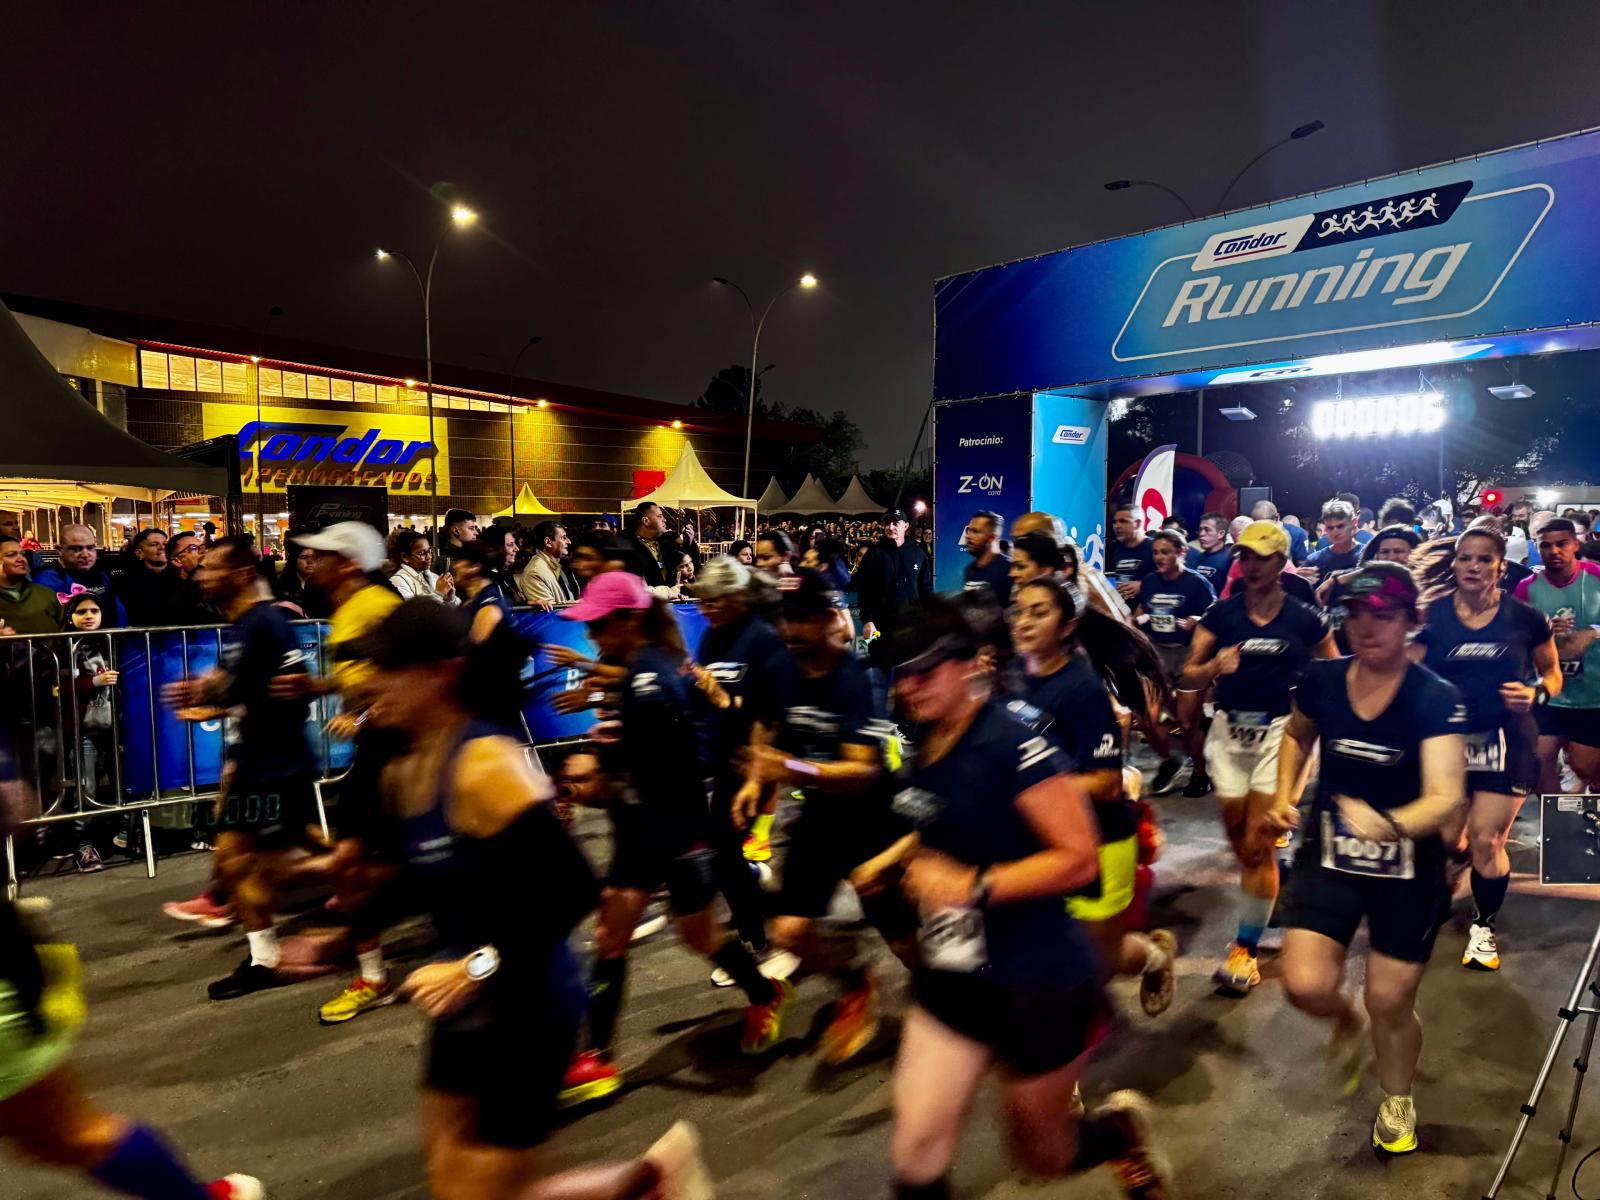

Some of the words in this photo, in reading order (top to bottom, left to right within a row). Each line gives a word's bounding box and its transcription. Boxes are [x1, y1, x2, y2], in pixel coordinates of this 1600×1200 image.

[1213, 230, 1288, 256] Condor
[1162, 242, 1473, 328] Running
[238, 421, 434, 465] Condor
[958, 434, 1004, 448] Patrocínio:
[1060, 429, 1084, 439] Condor
[957, 473, 1004, 494] Z-ON
[1333, 835, 1398, 861] 1007
